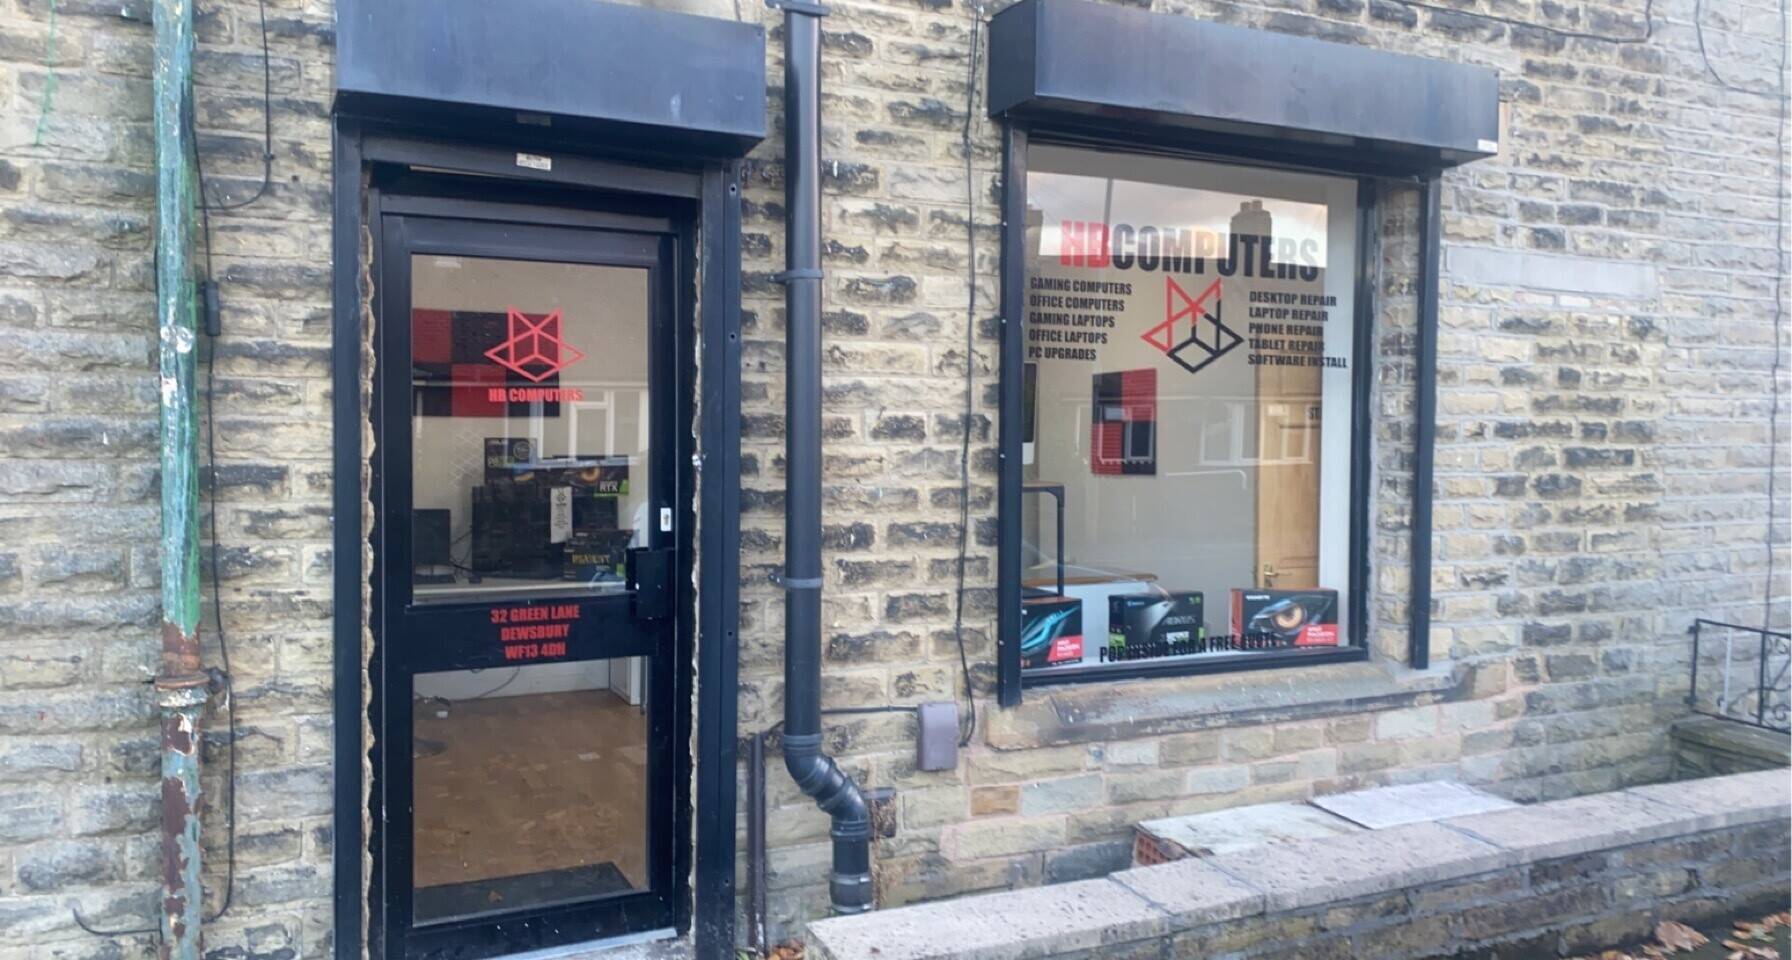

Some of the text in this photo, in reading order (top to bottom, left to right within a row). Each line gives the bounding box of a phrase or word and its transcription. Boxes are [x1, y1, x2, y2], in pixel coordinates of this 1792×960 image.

[1030, 277, 1132, 295] GAMING COMPUTERS
[1029, 294, 1125, 312] OFFICE COMPUTERS
[1249, 291, 1337, 307] DESKTOP REPAIR
[1029, 312, 1115, 328] GAMING LAPTOPS
[1249, 307, 1328, 321] LAPTOP REPAIR
[1029, 329, 1108, 344] OFFICE LAPTOPS
[1249, 322, 1323, 336] PHONE REPAIR
[1028, 346, 1096, 360] PC UPGRADES
[1248, 338, 1324, 352] TABLET REPAIR
[1248, 354, 1347, 368] SOFTWARE INSTALL
[488, 387, 583, 403] HB COMPUTERS
[490, 604, 581, 624] 32 GREEN LANE
[501, 623, 570, 641] DEWSBURY
[505, 644, 538, 660] WF13
[1099, 645, 1125, 663] POP
[1209, 634, 1238, 651] FREE
